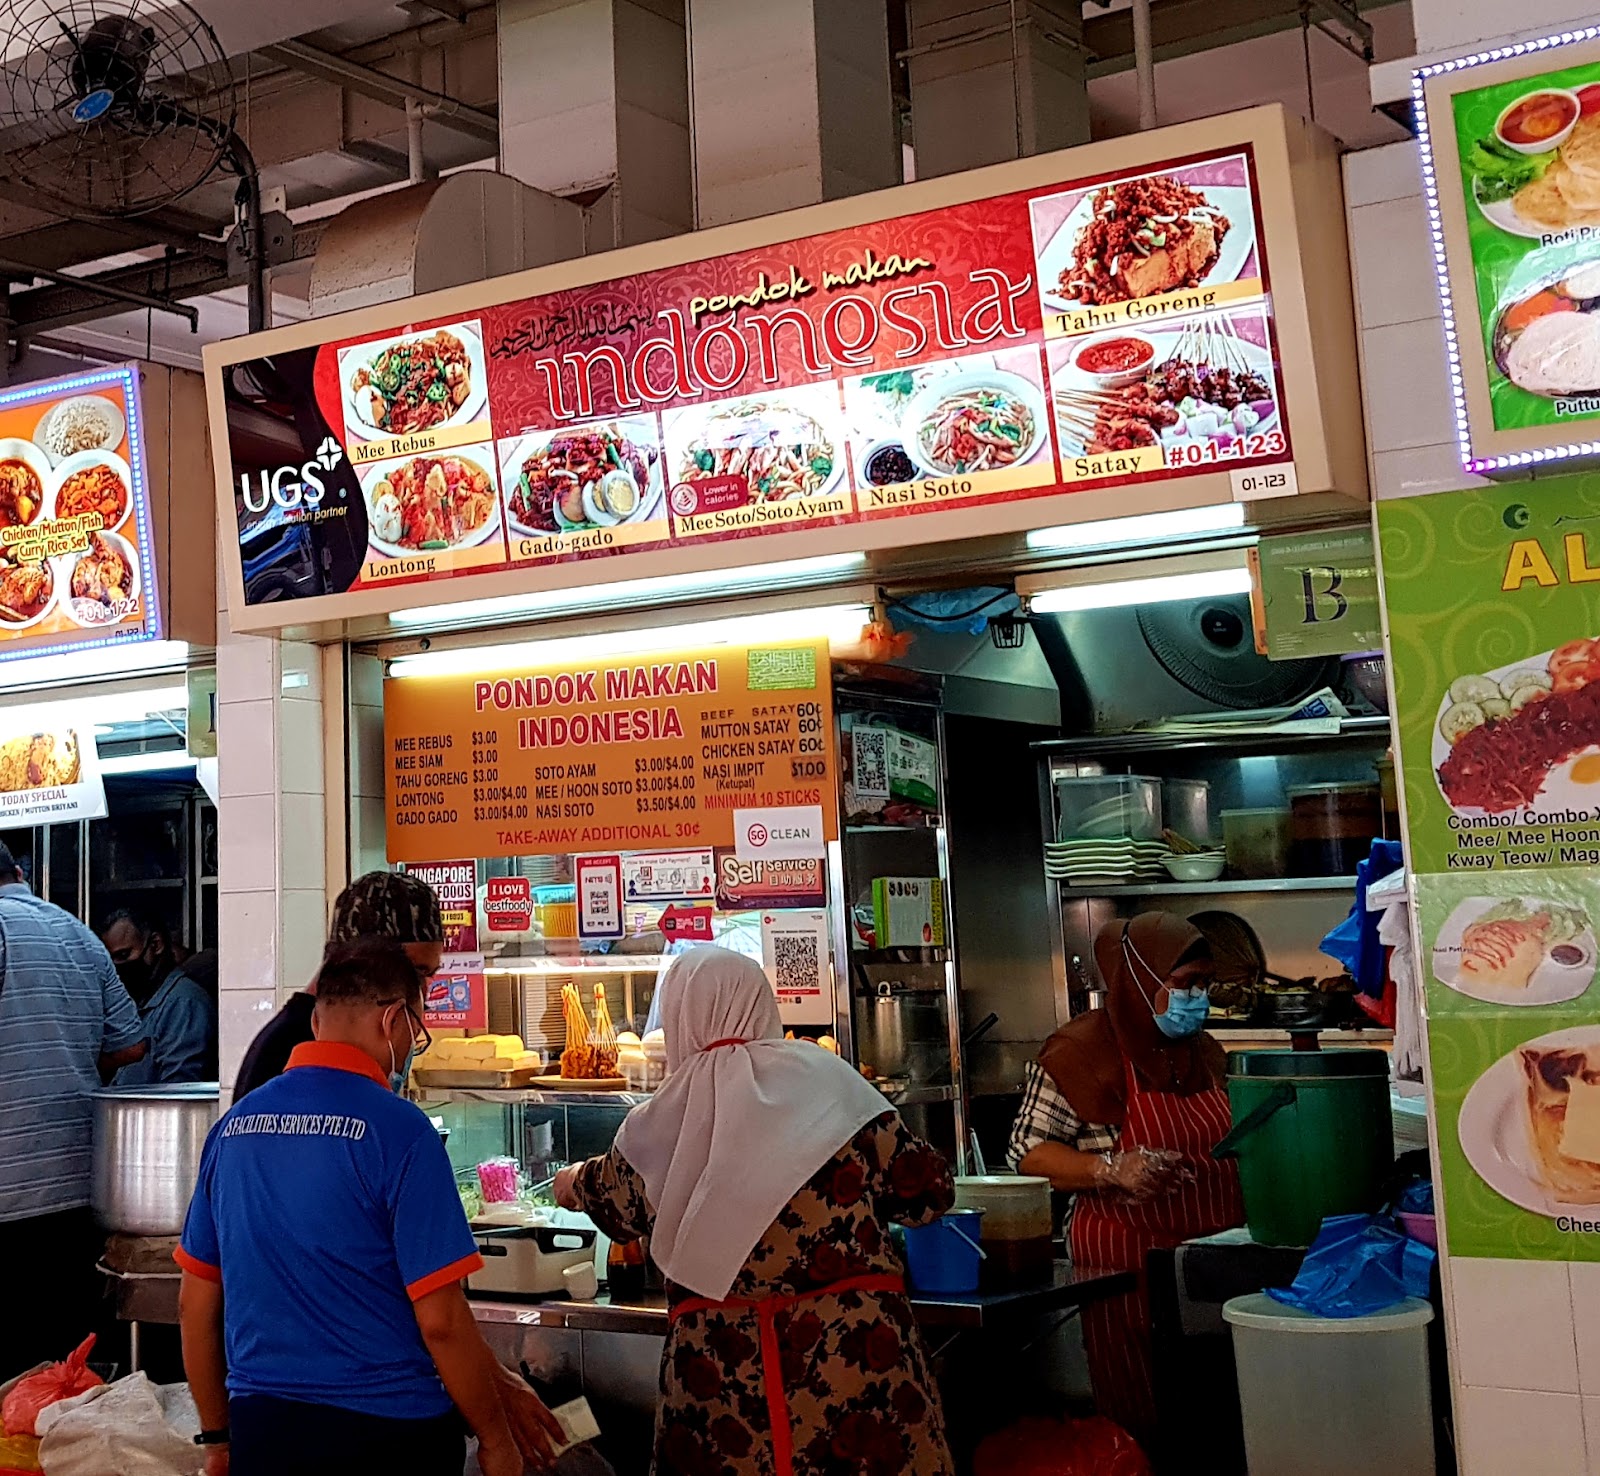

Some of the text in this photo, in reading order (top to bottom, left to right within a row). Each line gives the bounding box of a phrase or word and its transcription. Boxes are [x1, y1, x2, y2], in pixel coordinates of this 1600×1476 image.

[1580, 226, 1600, 240] Pr
[689, 249, 930, 325] pondok makan
[1056, 291, 1216, 332] Tahu Goreng
[536, 268, 1031, 420] indonesia
[1556, 399, 1600, 415] Puttu
[356, 433, 436, 461] Mee Rebus
[1168, 432, 1286, 467] #01-123
[1075, 454, 1141, 477] Satay
[241, 461, 325, 513] UGS
[703, 483, 738, 496] Lower in
[870, 478, 972, 506] Nasi Soto
[1242, 474, 1286, 491] 01-123
[705, 492, 739, 505] calories
[315, 506, 347, 523] partner
[681, 499, 844, 533] Mee Soto/Soto Ayam
[2, 513, 103, 543] Chicken/Mutton/Fish
[19, 537, 88, 559] Curry Rice Set
[519, 530, 614, 557] Gado-gado
[369, 556, 437, 580] Lontong
[1301, 565, 1348, 623] B
[77, 599, 139, 620] #01-122
[474, 671, 599, 712] PONDOK
[605, 659, 719, 702] MAKAN
[700, 708, 734, 720] BEEF
[752, 704, 795, 717] SATAY
[518, 706, 683, 749] INDONESIA
[701, 722, 750, 740] MUTTON
[753, 718, 790, 735] SATAY
[395, 731, 497, 751] MEE REBUS $3.00
[702, 741, 754, 760] CHICKEN
[758, 738, 795, 755] SATAY
[395, 750, 498, 770] MEE SIAM $3.00
[535, 755, 694, 780] SOTO AYAM $3.00/$4.00
[703, 763, 731, 779] NASI
[734, 761, 765, 777] IMPIT
[396, 768, 498, 788] TAHU GORENG $3.00
[536, 775, 695, 800] MEE / HOON SOTO $3.00/$4.00
[1, 788, 68, 806] TODAY SPECIAL
[396, 786, 527, 807] LONTONG $3.00/$4.00
[536, 796, 696, 819] NASI SOTO $3.50/$4.00
[705, 788, 821, 809] MINIMUM 10 STICKS
[396, 805, 528, 825] GADO GADO $3.00/$4.00
[1447, 810, 1518, 829] Combo/
[1523, 808, 1590, 826] Combo
[497, 821, 700, 845] TAKE-AWAY ADDITIONAL 30¢
[750, 828, 811, 840] SG CLEAN
[1457, 828, 1600, 848] Mee/ Mee Hoon
[1447, 847, 1599, 869] Kway Teow/ Mag
[406, 866, 474, 884] SINGAPORE
[723, 857, 817, 888] Self Service
[437, 884, 472, 899] FOODS
[492, 884, 525, 896] I LOVE
[484, 898, 532, 915] bestfoody
[231, 1113, 279, 1136] FACILITIES
[278, 1114, 323, 1136] SERVICES
[323, 1115, 343, 1136] PTE
[342, 1116, 366, 1141] LTD
[1556, 1216, 1600, 1233] Chee
